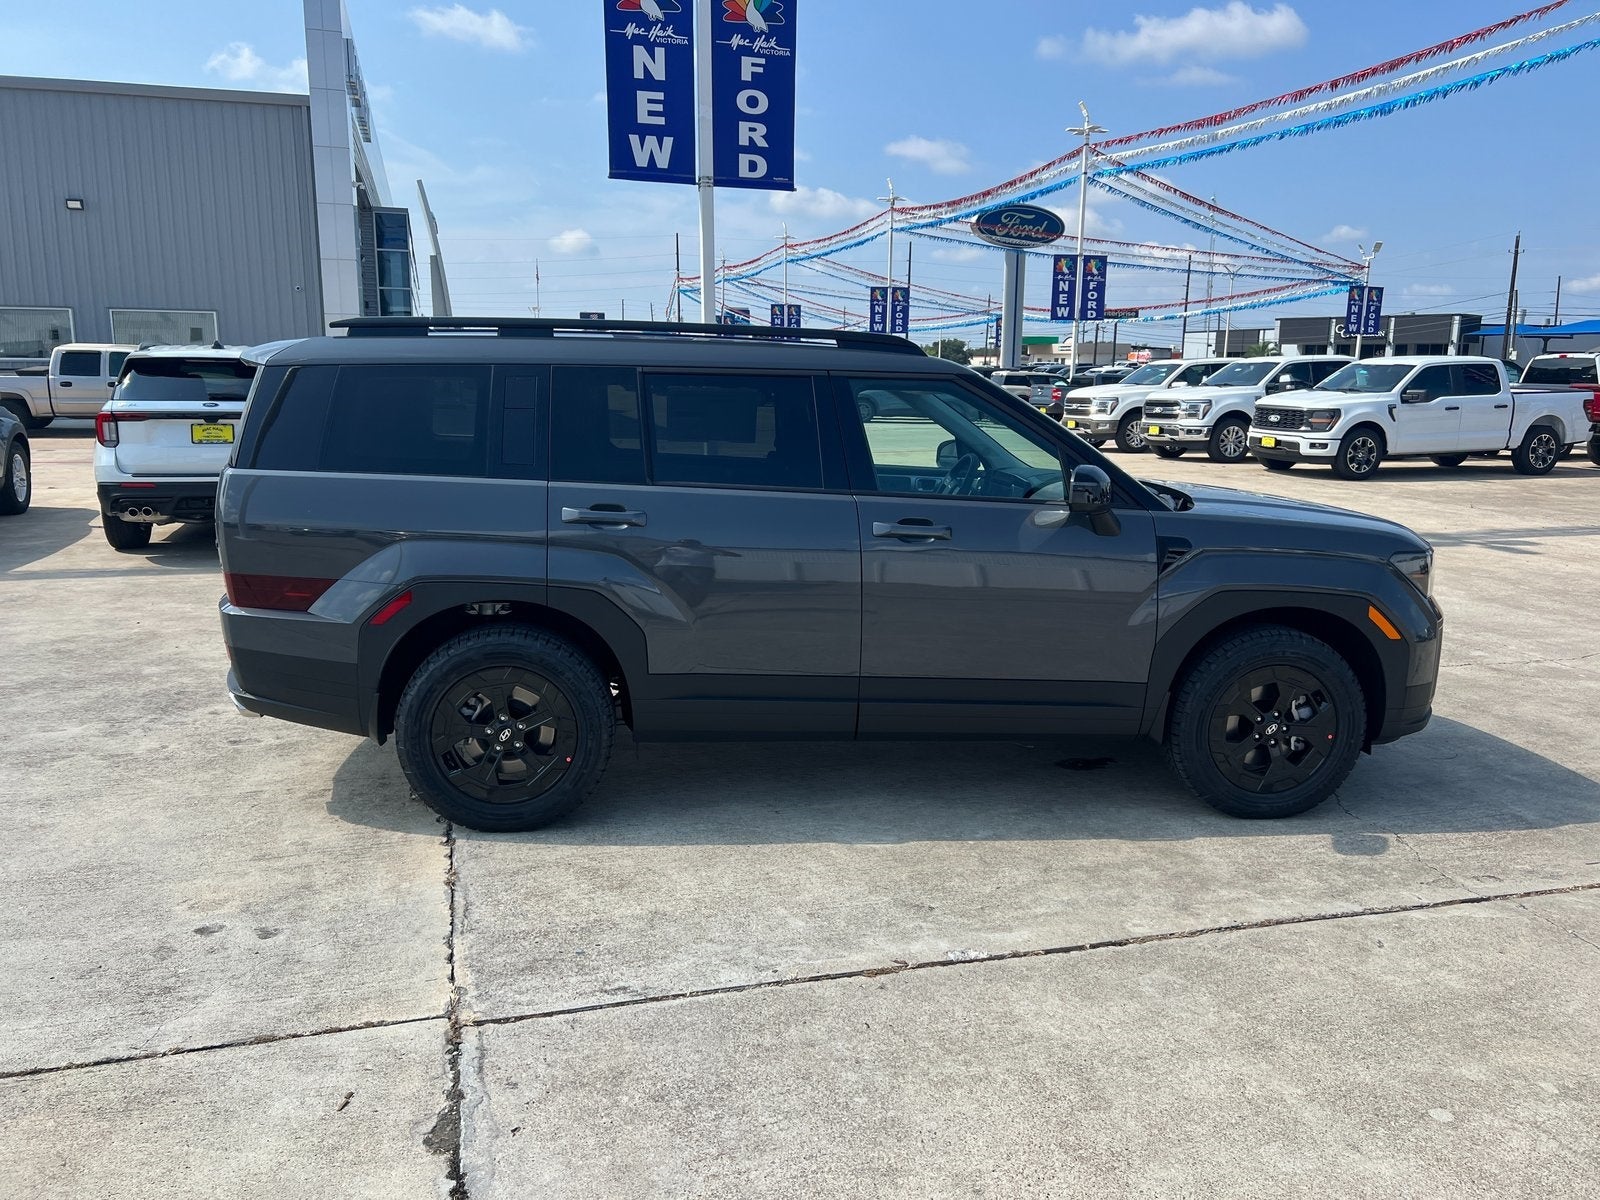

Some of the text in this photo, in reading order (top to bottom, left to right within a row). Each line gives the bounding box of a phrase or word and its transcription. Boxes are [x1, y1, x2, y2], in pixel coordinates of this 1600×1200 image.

[619, 22, 681, 42] Mac Haik
[655, 37, 689, 45] VICTORIA
[725, 33, 784, 53] Mac Haik
[759, 48, 791, 57] VICTORIA
[628, 45, 674, 169] NEW
[736, 55, 769, 179] FORD
[1056, 280, 1070, 318] NEW
[1087, 281, 1098, 318] FORD
